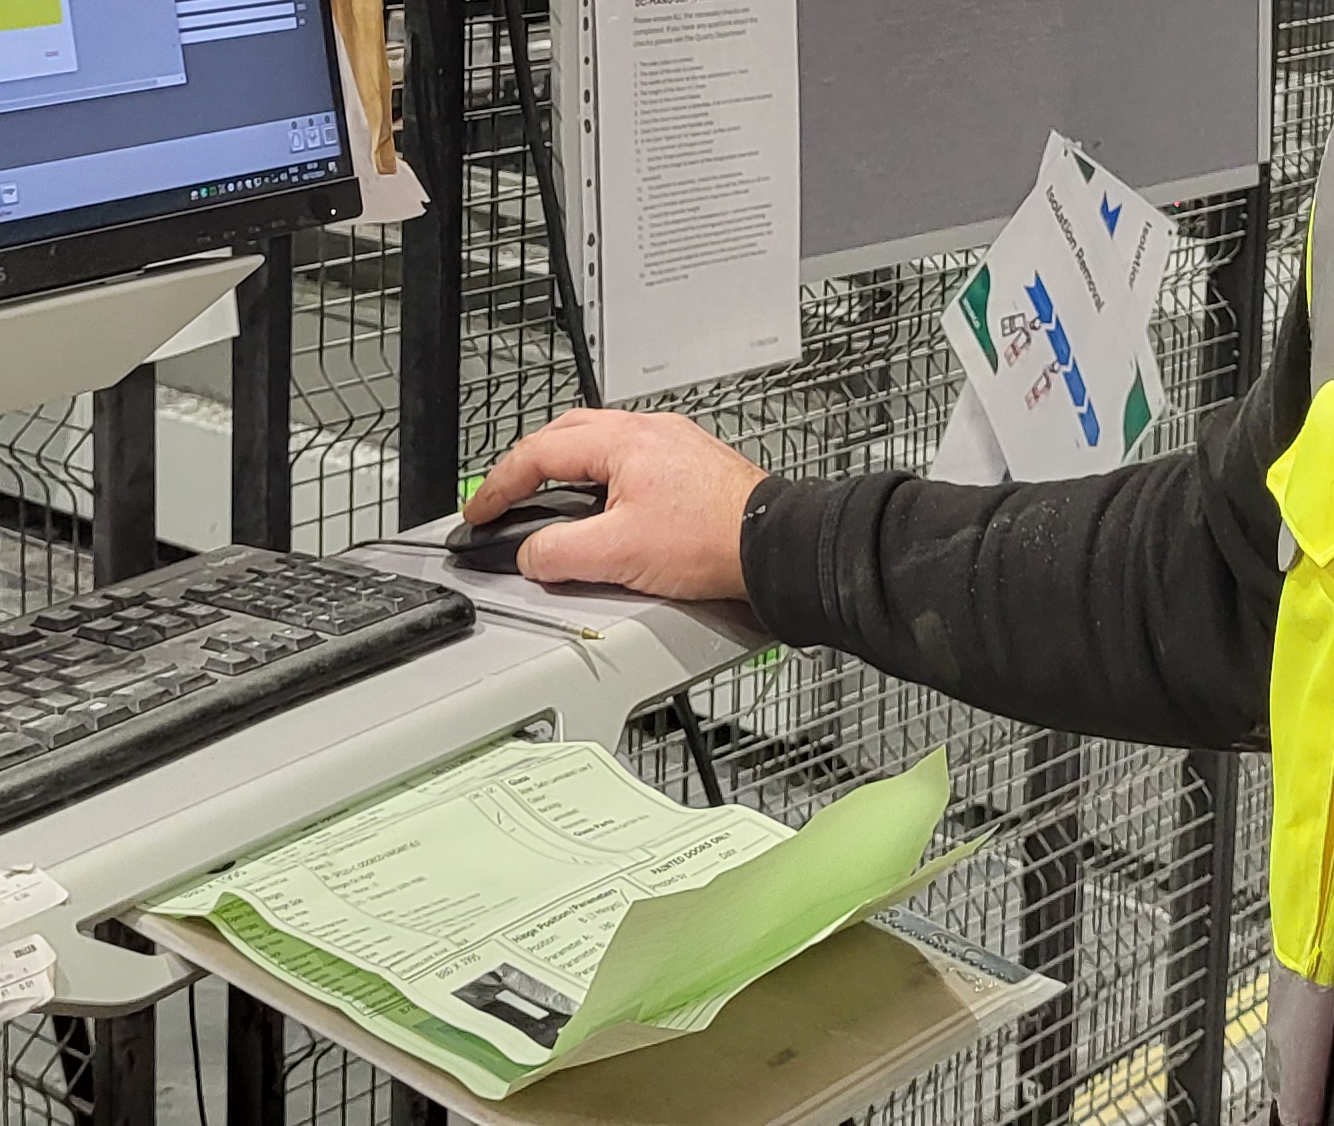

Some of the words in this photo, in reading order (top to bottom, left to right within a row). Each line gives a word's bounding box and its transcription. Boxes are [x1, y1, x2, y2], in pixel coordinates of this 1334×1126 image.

[1045, 185, 1078, 251] Isolation
[1074, 247, 1106, 314] Removal
[508, 775, 531, 787] Glass
[650, 855, 685, 876] PAINTED
[685, 841, 711, 861] DOORS
[711, 832, 732, 846] ONLY
[511, 926, 539, 944] Hinge
[537, 888, 618, 932] Position/Parameters
